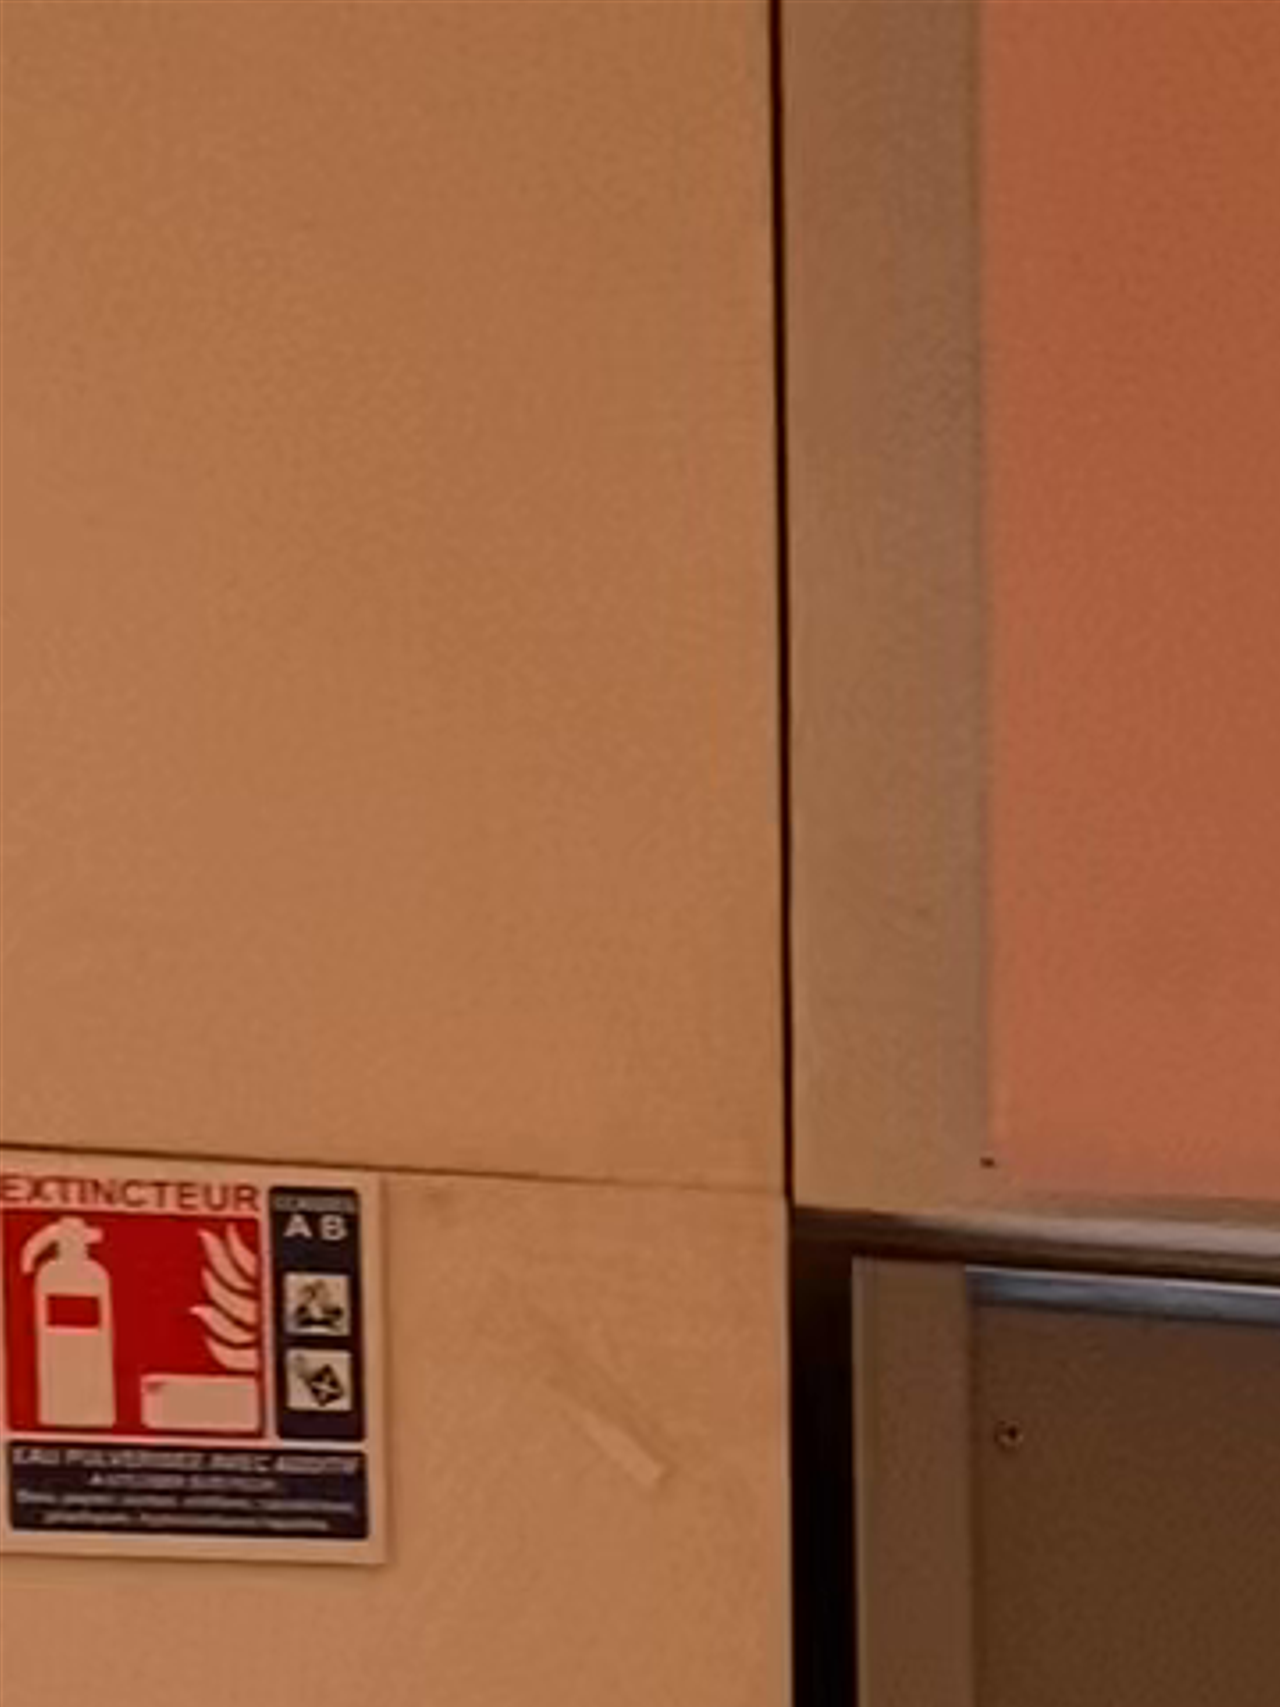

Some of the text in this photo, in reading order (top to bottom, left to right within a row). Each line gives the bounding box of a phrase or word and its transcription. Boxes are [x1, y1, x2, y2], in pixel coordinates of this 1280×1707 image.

[0, 1175, 260, 1212] EXTINCTEUR
[283, 1214, 347, 1240] A B
